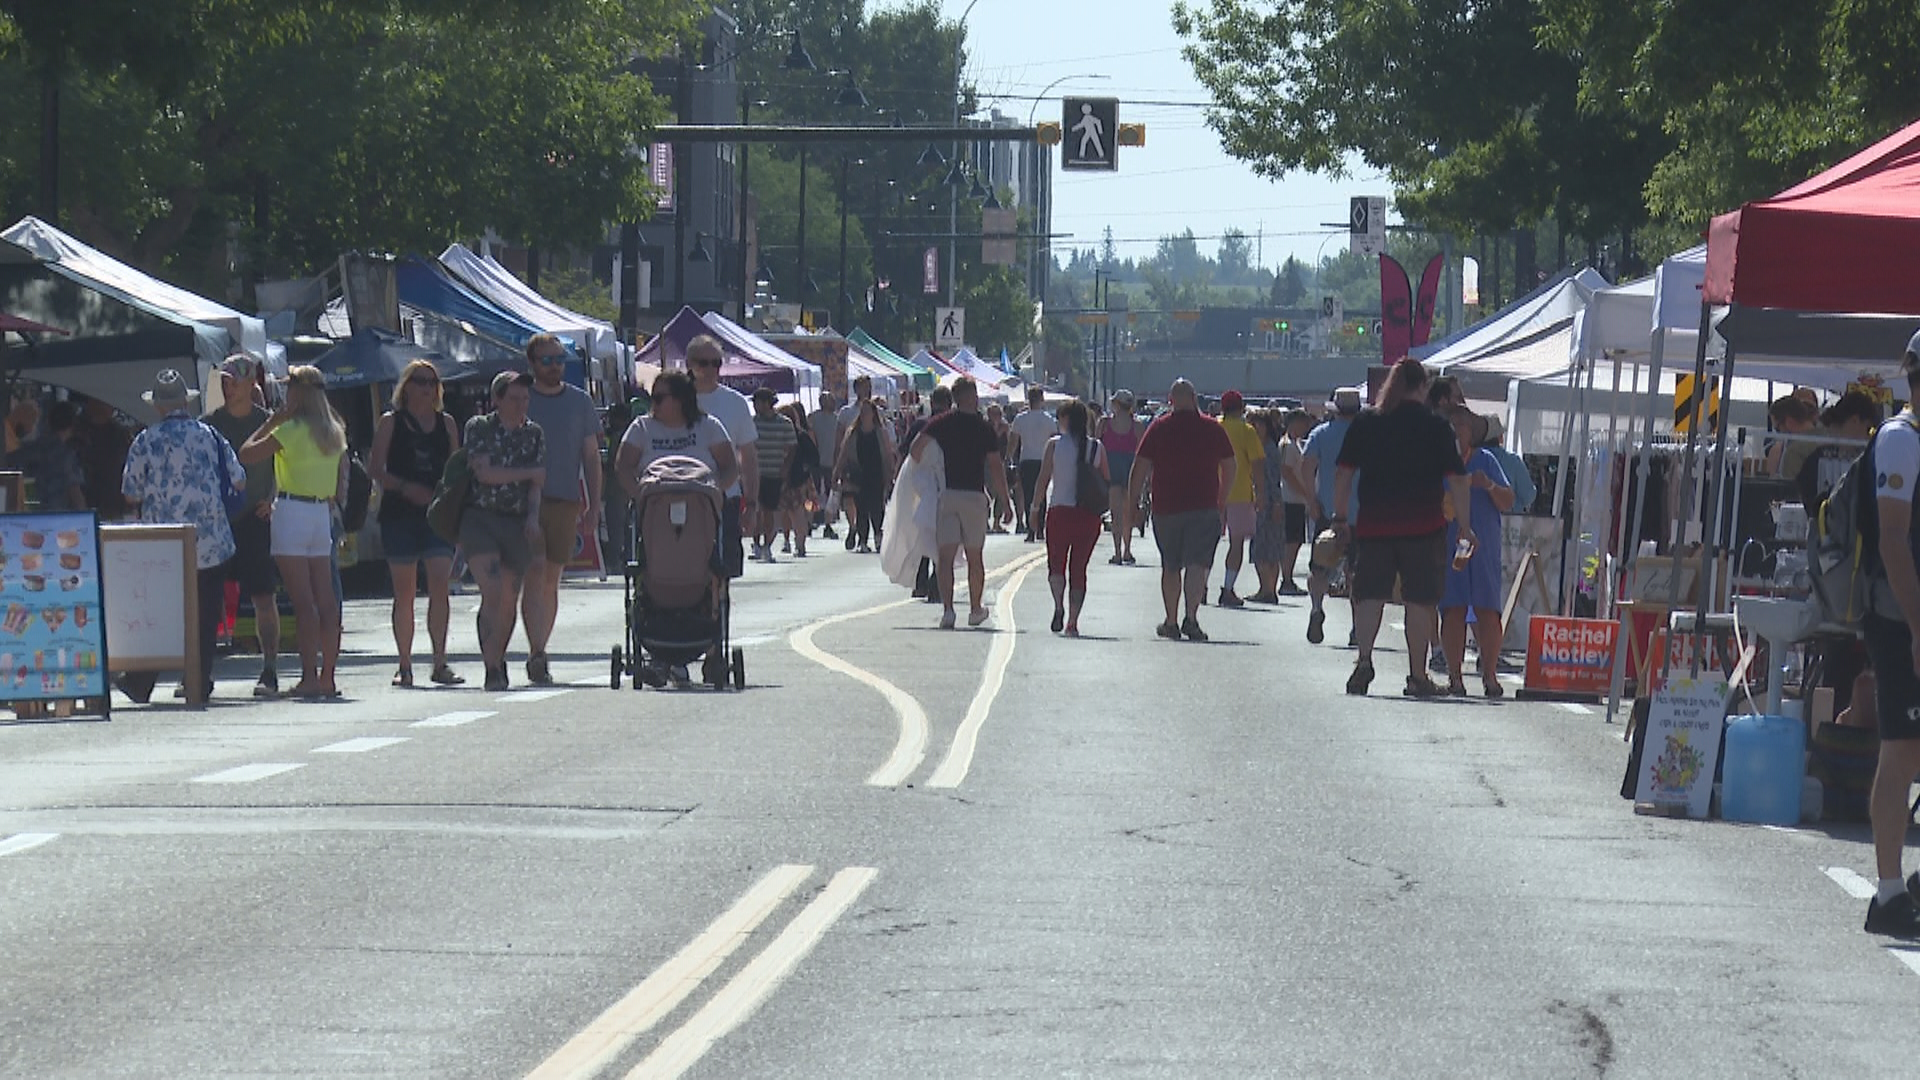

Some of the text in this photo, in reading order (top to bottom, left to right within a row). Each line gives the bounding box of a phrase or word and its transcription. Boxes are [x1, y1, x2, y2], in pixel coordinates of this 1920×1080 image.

[1543, 623, 1612, 646] Rachel
[1541, 643, 1610, 669] Notley
[1541, 668, 1608, 681] Fighting for you
